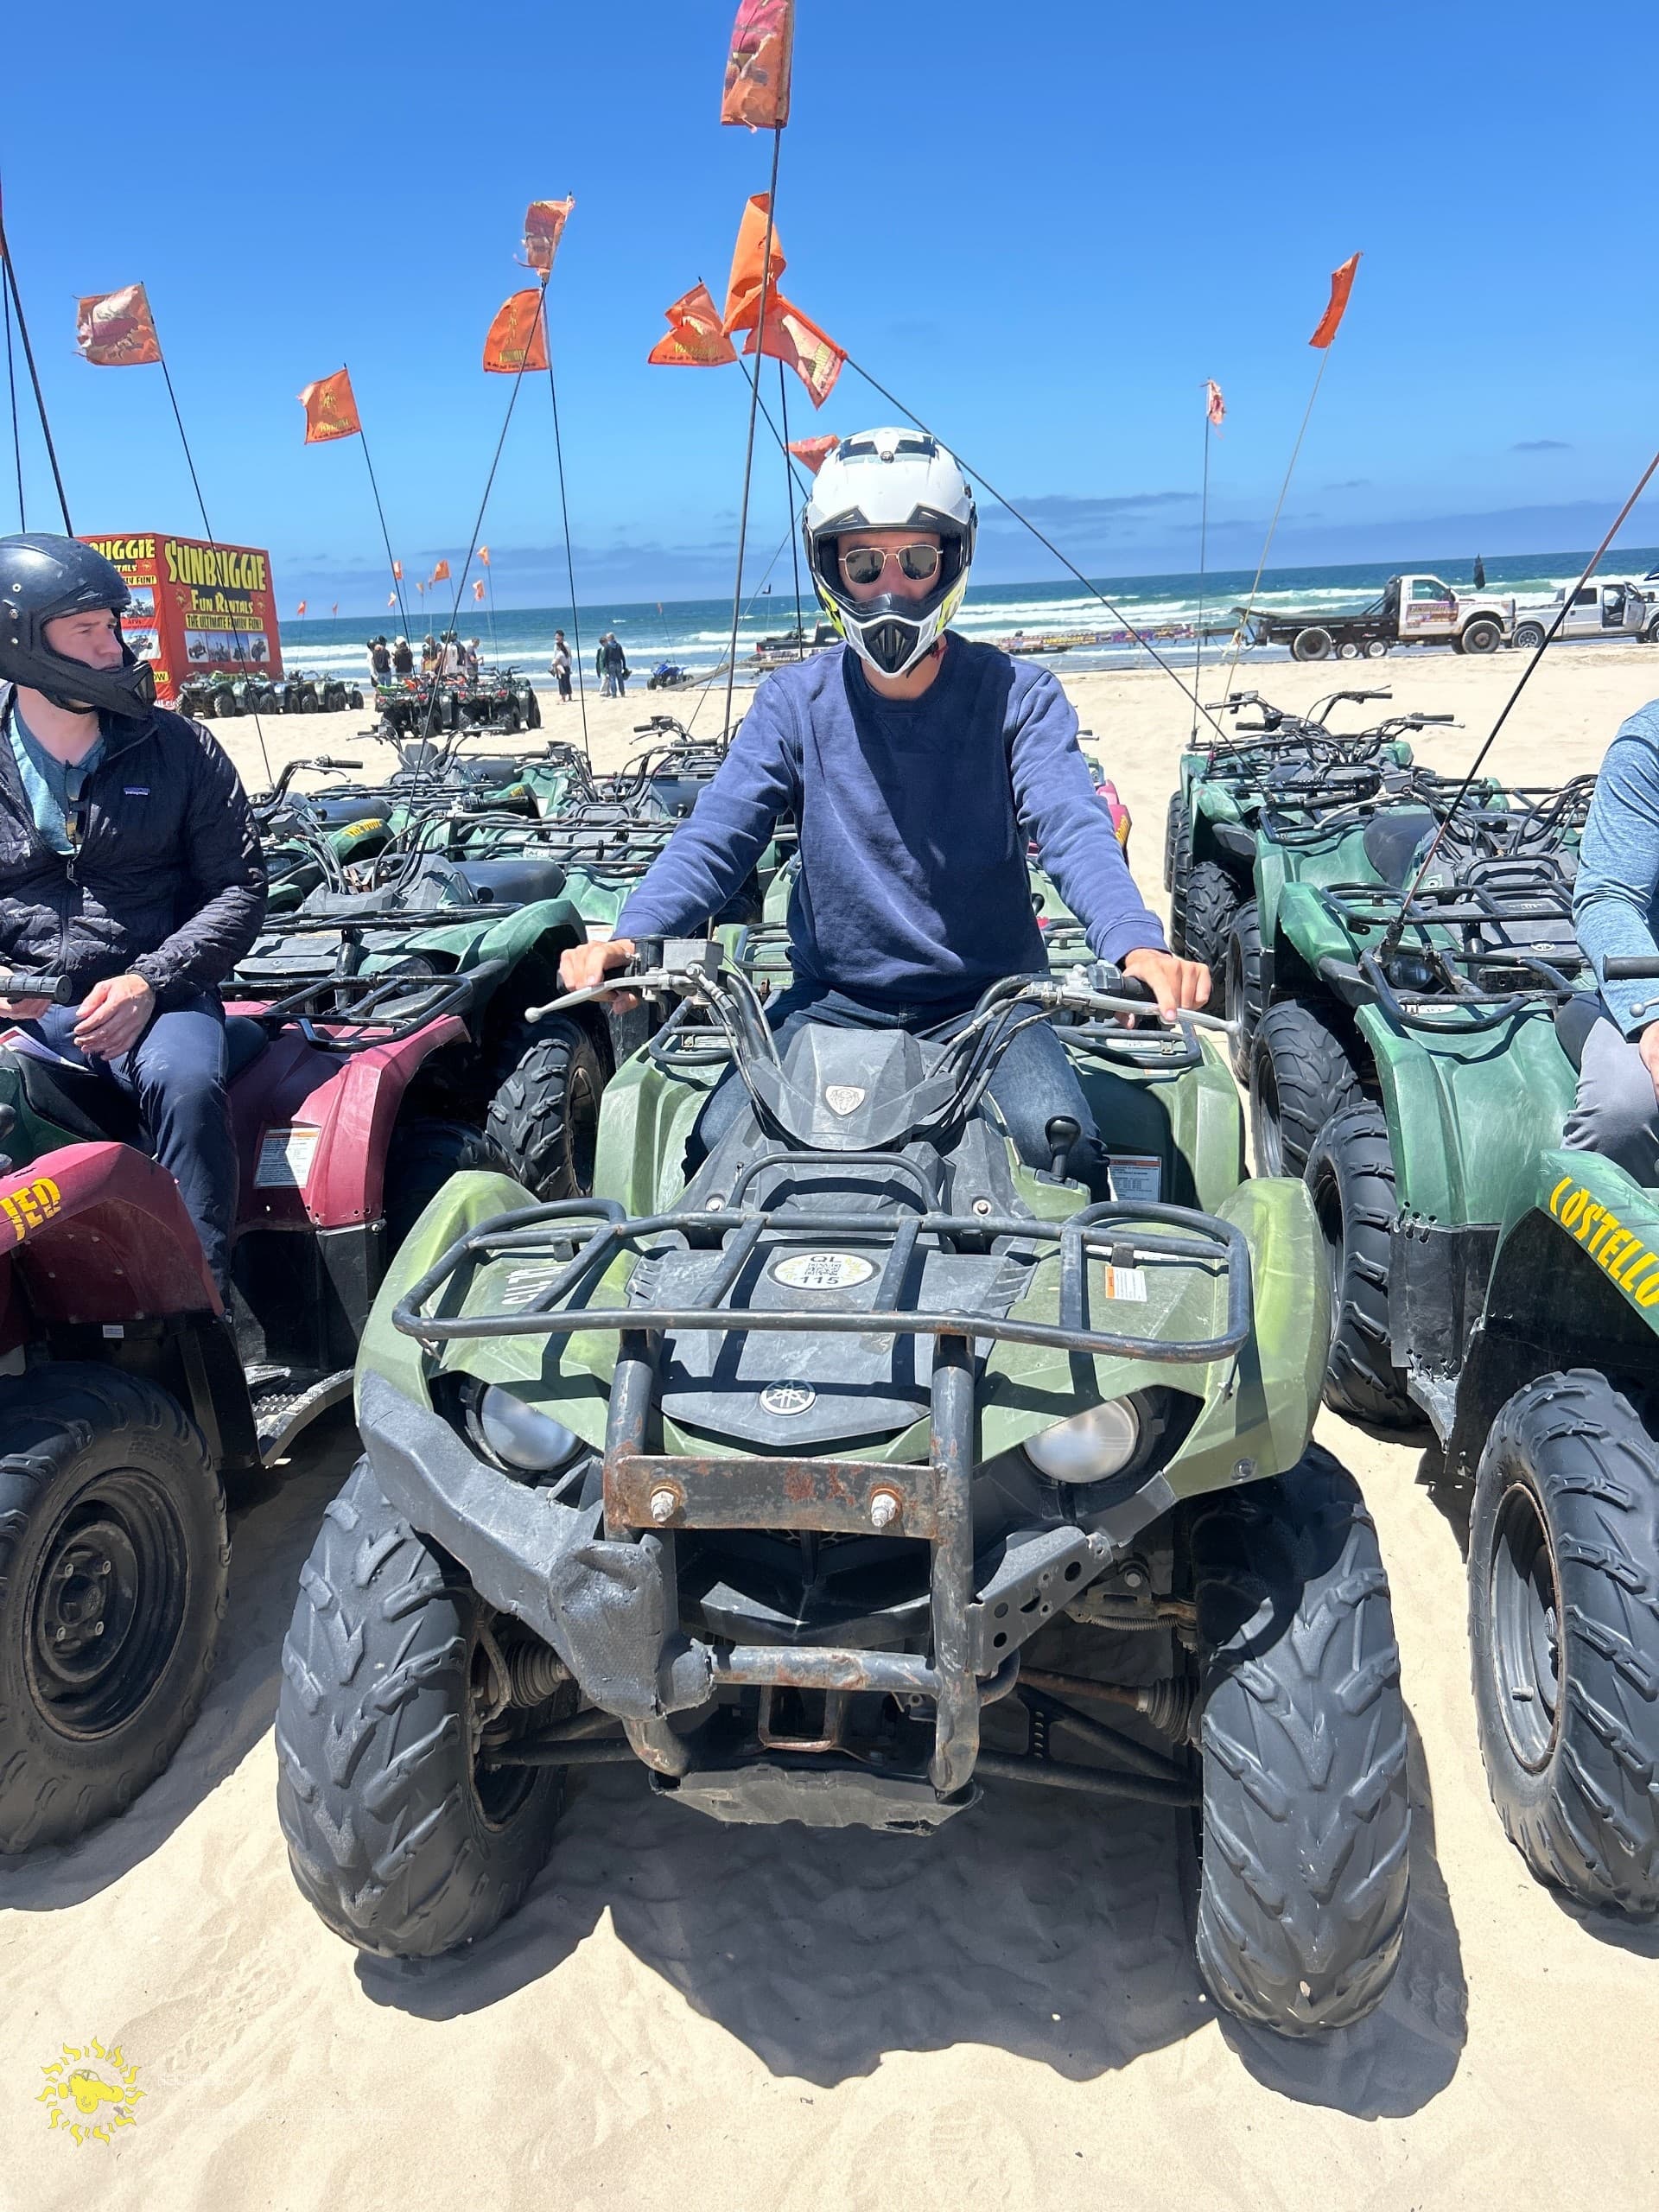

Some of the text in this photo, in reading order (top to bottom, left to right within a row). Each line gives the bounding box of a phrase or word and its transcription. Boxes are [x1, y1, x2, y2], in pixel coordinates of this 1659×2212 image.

[114, 564, 137, 573] TALS
[164, 539, 266, 591] SUNBUGGIE
[191, 589, 254, 614] FUN RENTALS
[187, 614, 199, 627] THE
[200, 615, 226, 629] ULTIMATE
